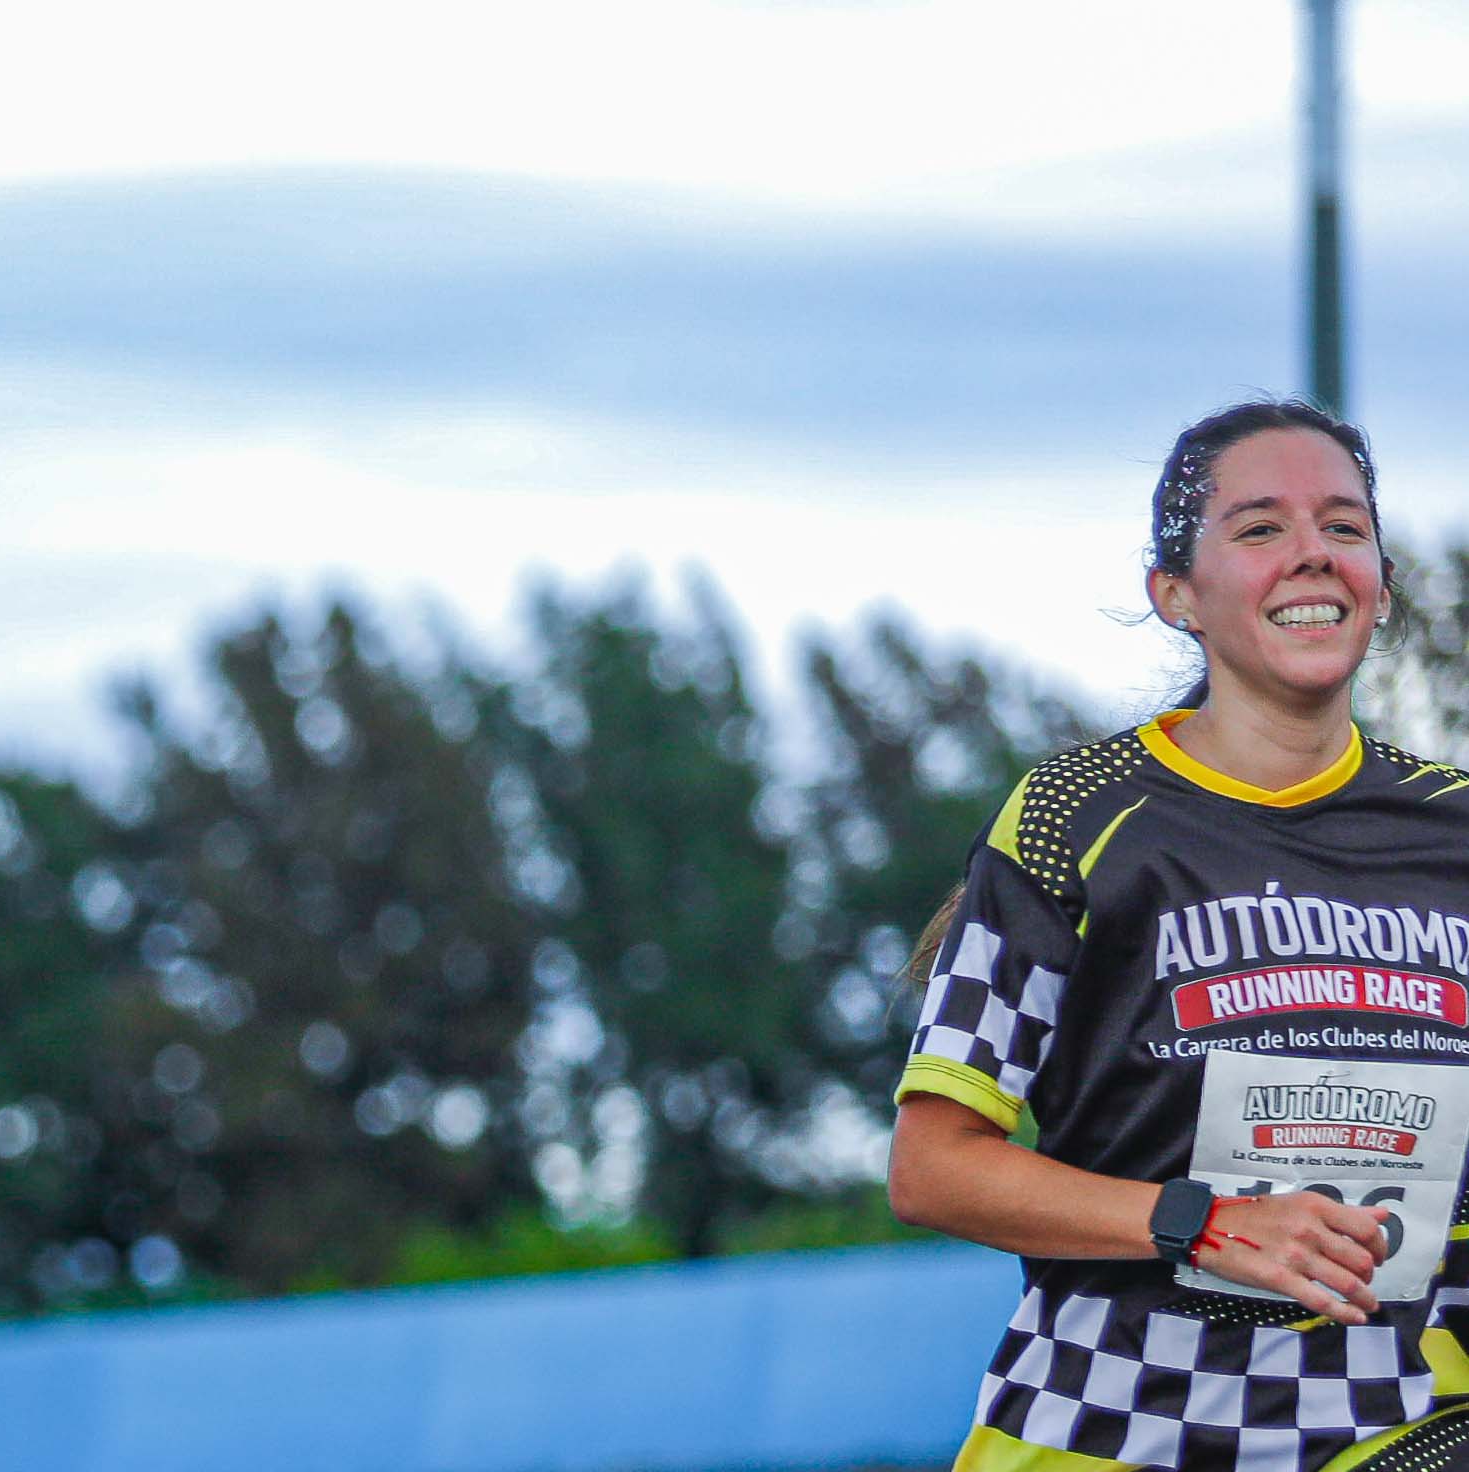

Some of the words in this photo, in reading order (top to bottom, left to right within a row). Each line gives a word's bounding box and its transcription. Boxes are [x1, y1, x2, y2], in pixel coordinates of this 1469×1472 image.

[1155, 880, 1469, 980] AUTÓDROMO
[1206, 969, 1356, 1019] RUNNING
[1363, 971, 1444, 1017] RACE
[1174, 1037, 1252, 1057] Carrera
[1256, 1029, 1284, 1049] de
[1288, 1027, 1319, 1047] los
[1322, 1026, 1386, 1048] Clubes
[1390, 1028, 1419, 1049] del
[1243, 1075, 1436, 1130] AUTÓDROMO
[1272, 1126, 1350, 1146] RUNNING
[1354, 1129, 1400, 1152] RACE
[1232, 1149, 1246, 1160] La
[1248, 1151, 1289, 1165] Carrera
[1291, 1154, 1305, 1165] de
[1307, 1155, 1322, 1166] los
[1324, 1156, 1359, 1167] Clubes
[1360, 1157, 1376, 1168] del
[1379, 1158, 1425, 1170] Noroeste
